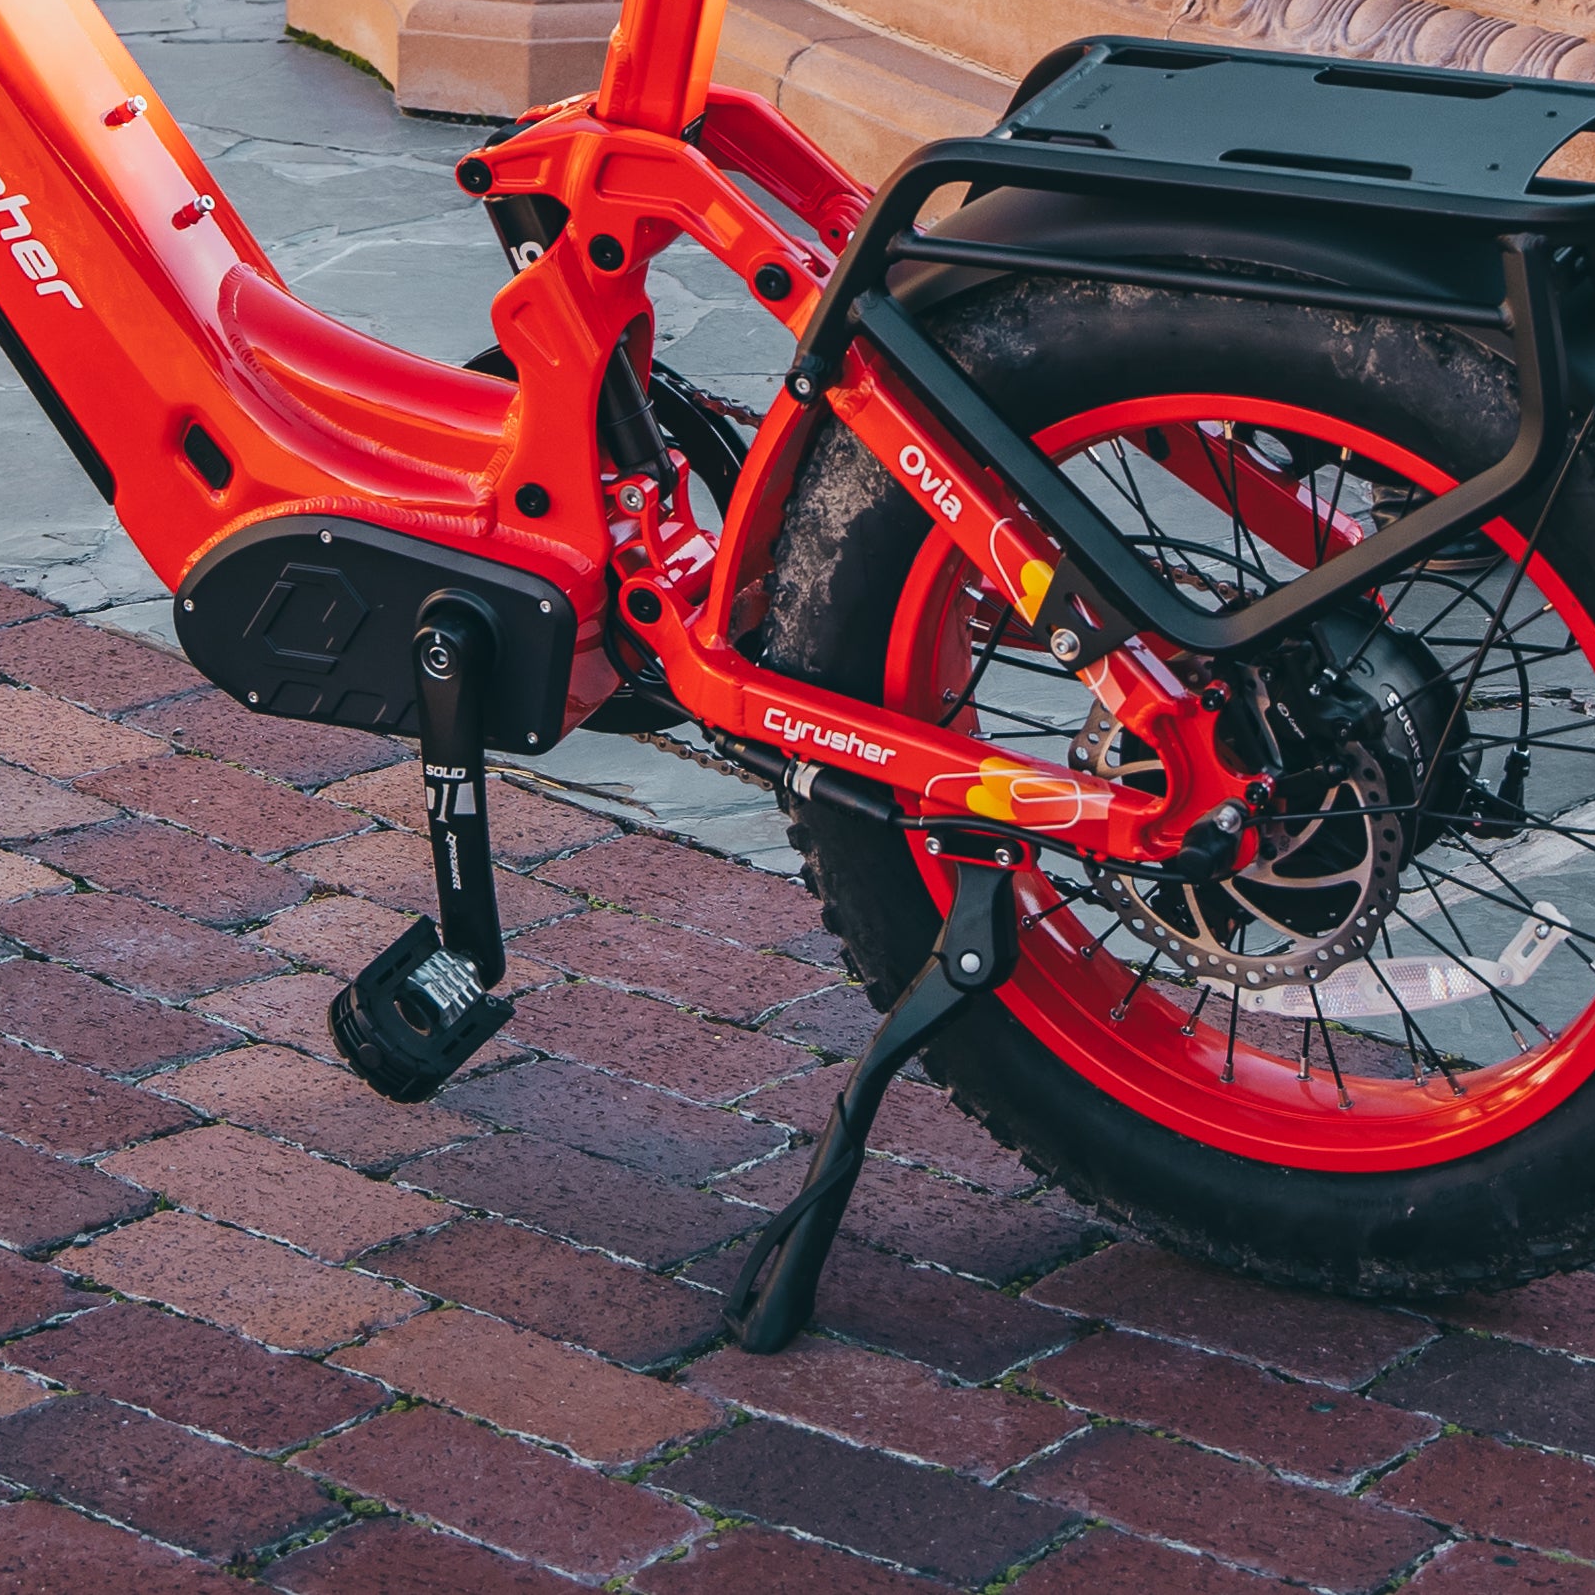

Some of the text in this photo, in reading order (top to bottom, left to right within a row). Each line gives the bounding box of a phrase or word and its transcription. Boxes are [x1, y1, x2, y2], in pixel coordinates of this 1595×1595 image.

[898, 444, 962, 523] Ovia
[763, 707, 897, 765] Cyrusher
[425, 764, 466, 780] SOLID
